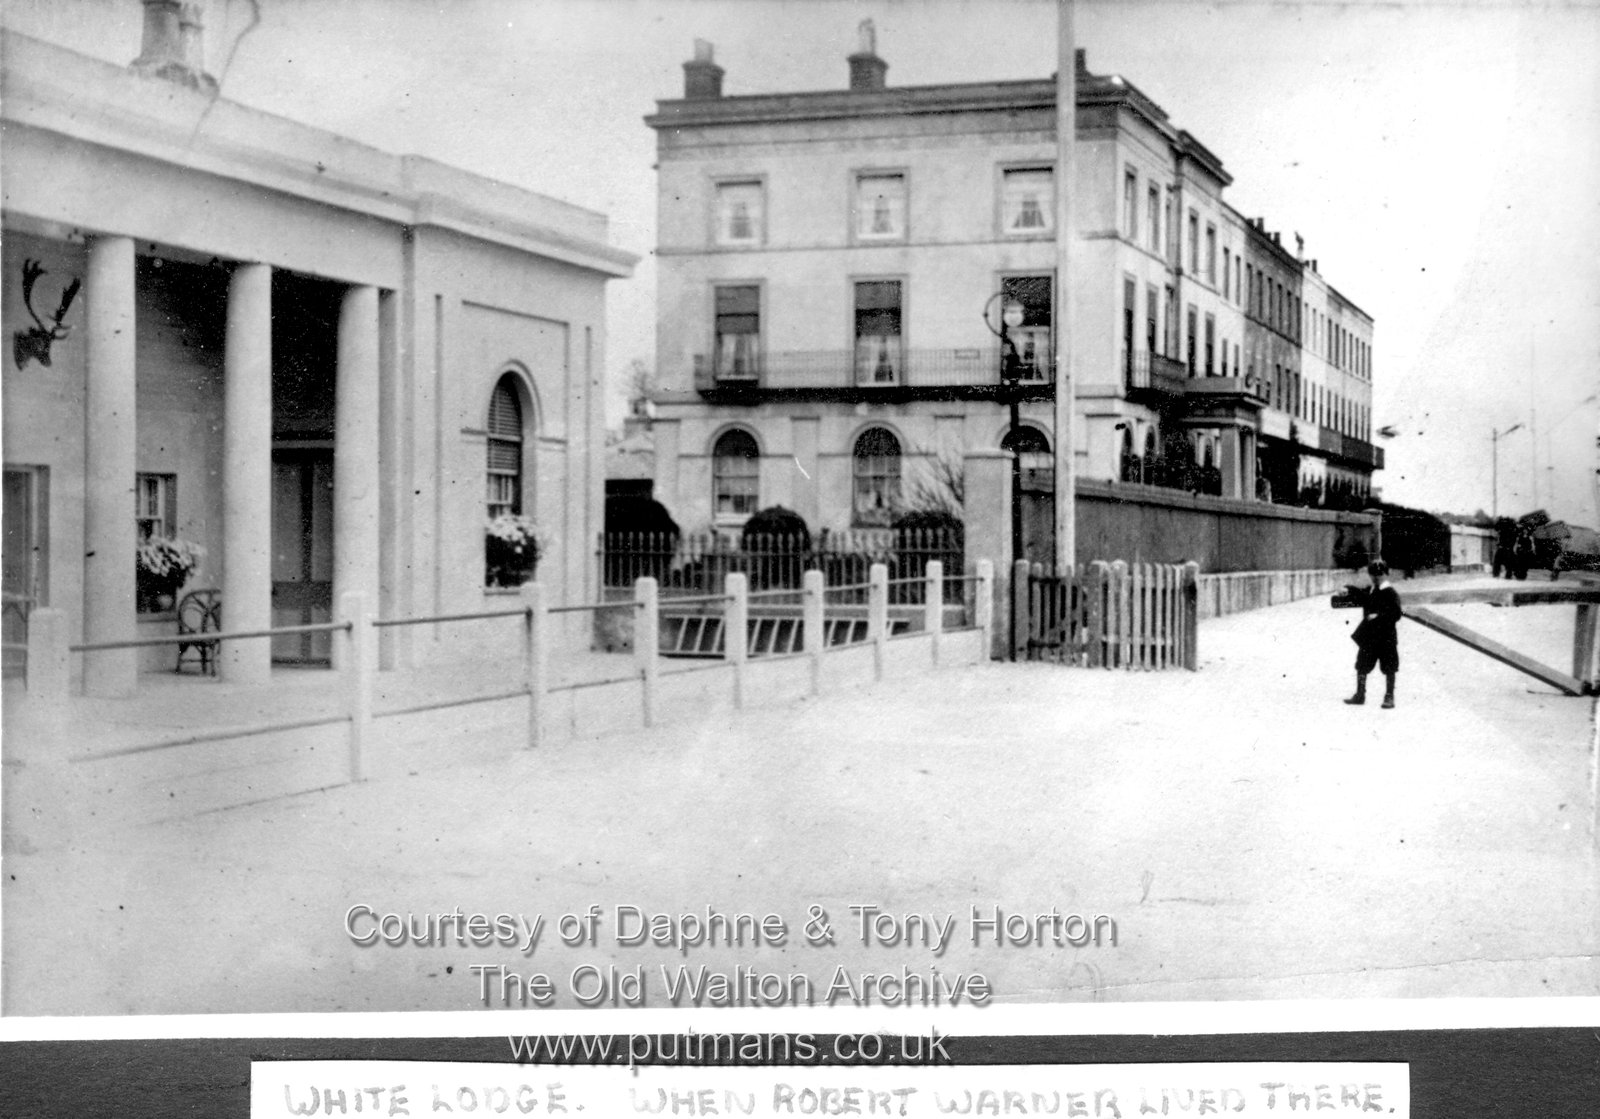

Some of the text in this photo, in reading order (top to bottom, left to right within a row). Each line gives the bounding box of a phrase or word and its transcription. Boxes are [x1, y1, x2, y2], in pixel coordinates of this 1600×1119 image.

[284, 1082, 1395, 1118] WHITE LODGE. WHEN ROBERT WARNER LIVED THERE.
